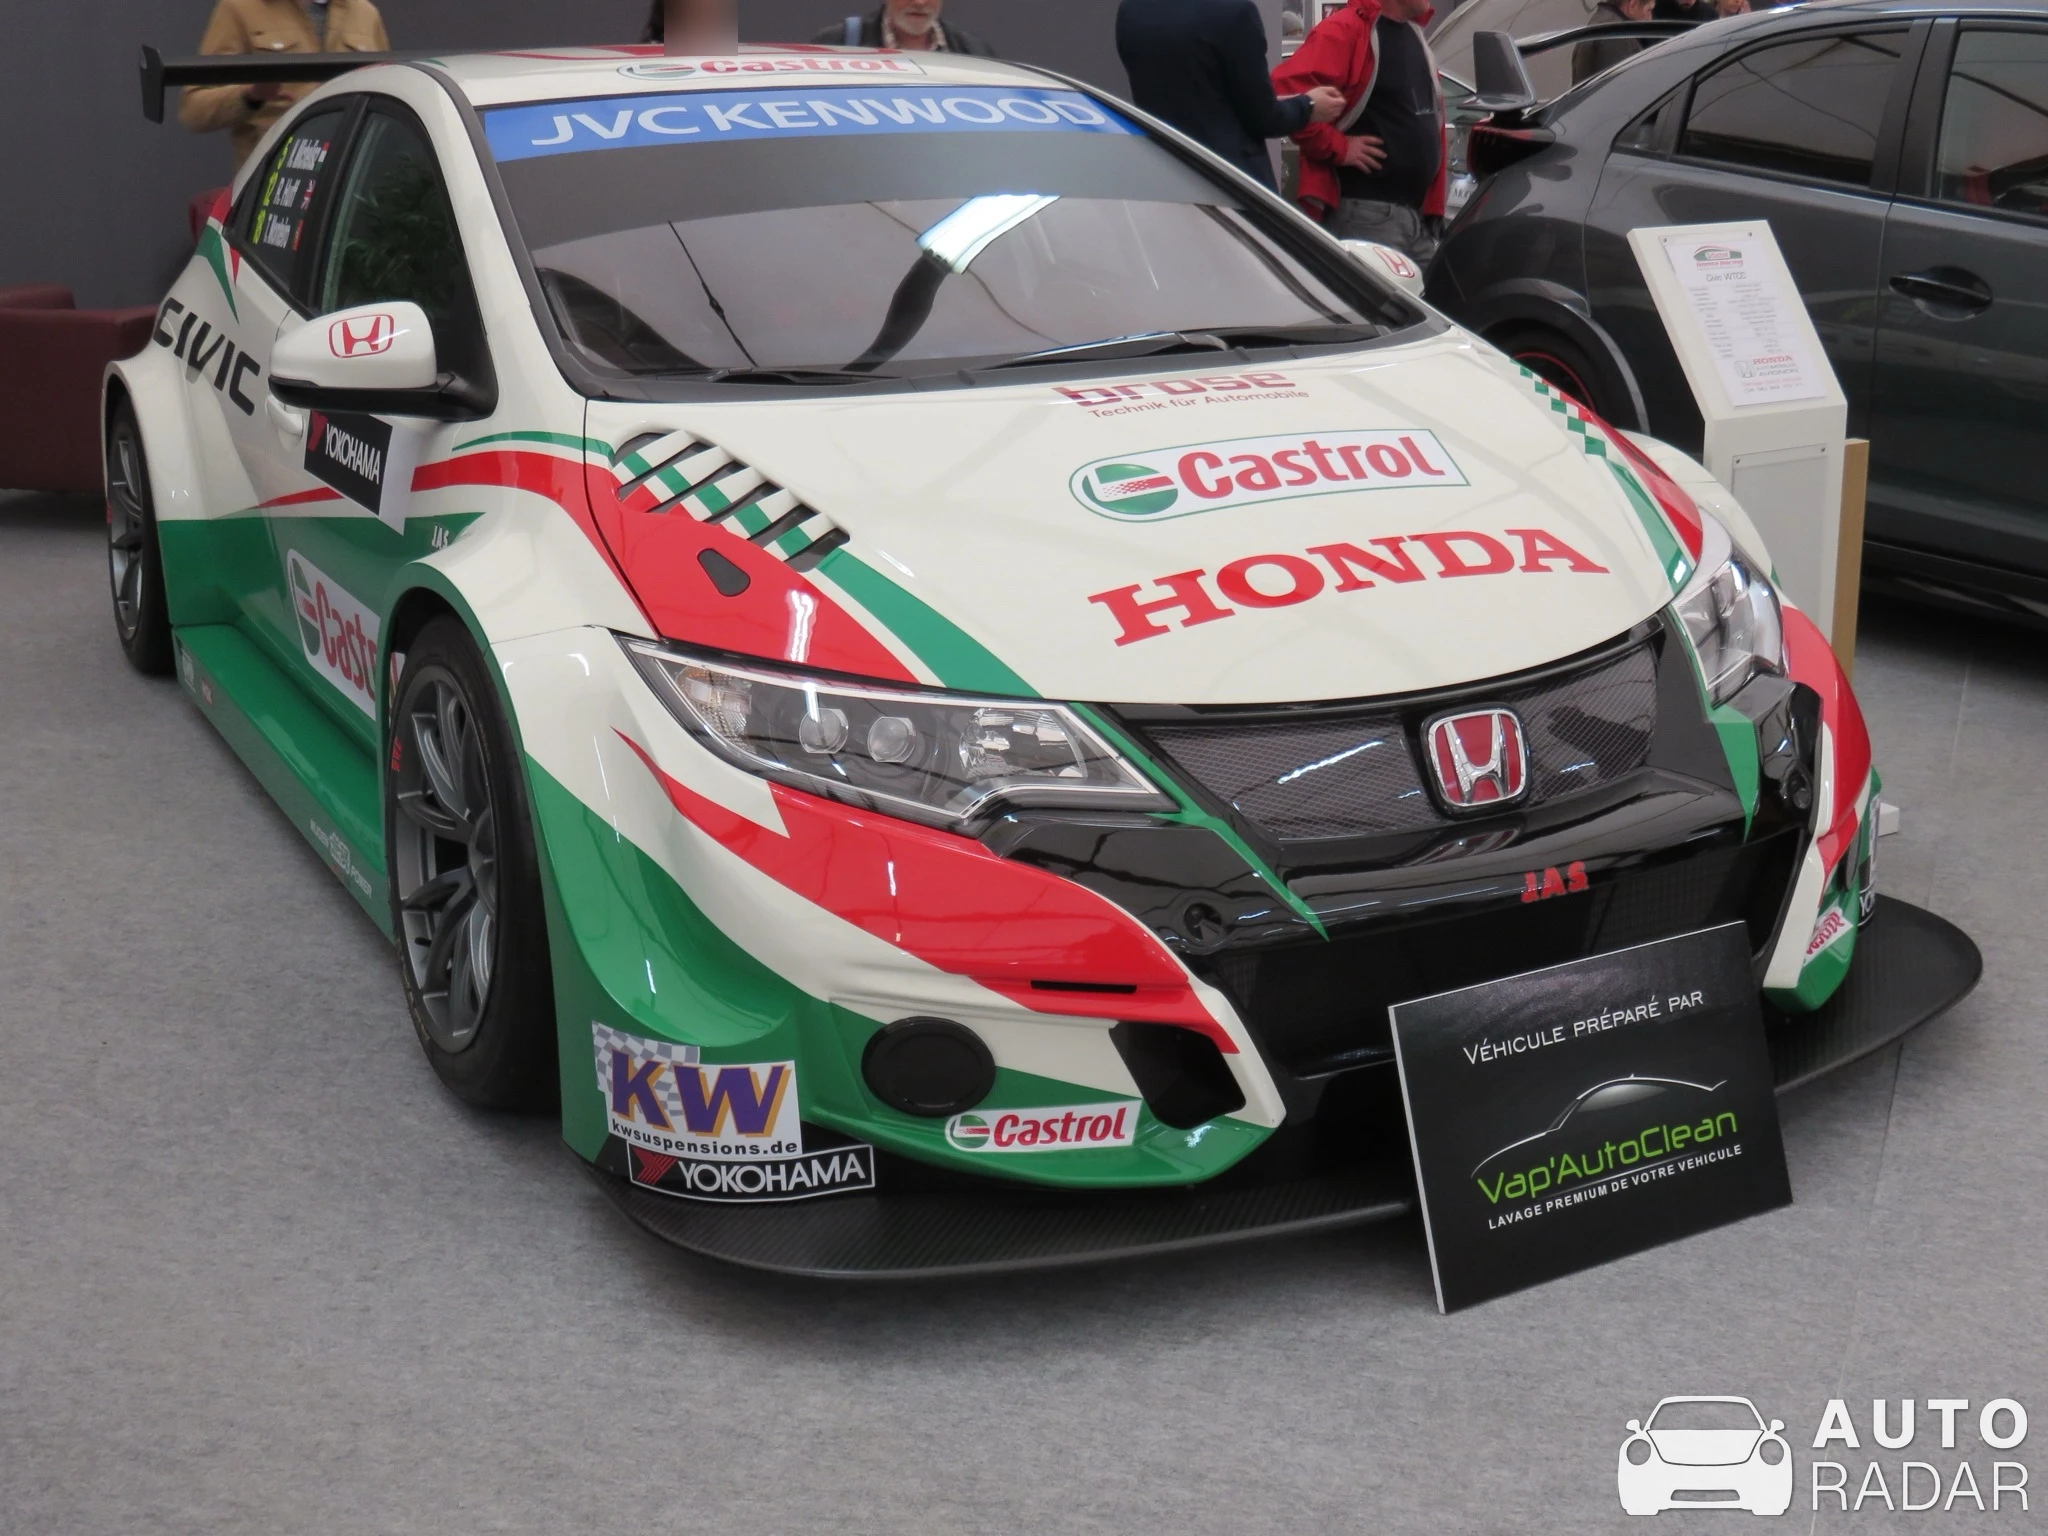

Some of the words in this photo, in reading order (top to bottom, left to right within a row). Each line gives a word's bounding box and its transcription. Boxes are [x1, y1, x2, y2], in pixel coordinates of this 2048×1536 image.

[700, 57, 907, 75] Castrol
[153, 297, 260, 416] CIVIC
[1752, 355, 1793, 365] HONDA
[1051, 372, 1296, 407] brose
[1088, 399, 1169, 418] Technik
[1170, 397, 1197, 409] für
[1205, 389, 1309, 404] Automobile
[325, 423, 381, 485] YOKOHAMA
[1177, 436, 1445, 499] Castrol
[1087, 528, 1610, 647] HONDA
[1520, 861, 1590, 904] JAS
[1463, 1026, 1566, 1064] VÉHICULE
[1573, 995, 1661, 1037] PRÉPARÉ
[1668, 991, 1704, 1013] PAR
[611, 1048, 792, 1138] KW
[612, 1119, 798, 1155] kwsuspensions.de
[993, 1107, 1127, 1147] Castrol
[678, 1152, 867, 1193] YOKOHAMA
[1478, 1111, 1738, 1204] Vap'AutoClean
[1488, 1204, 1543, 1230] LAVAGE
[1546, 1184, 1608, 1212] PREMIUM
[1611, 1178, 1629, 1193] DE
[1631, 1164, 1676, 1186] VOTRE
[1677, 1144, 1742, 1173] VEHICULE
